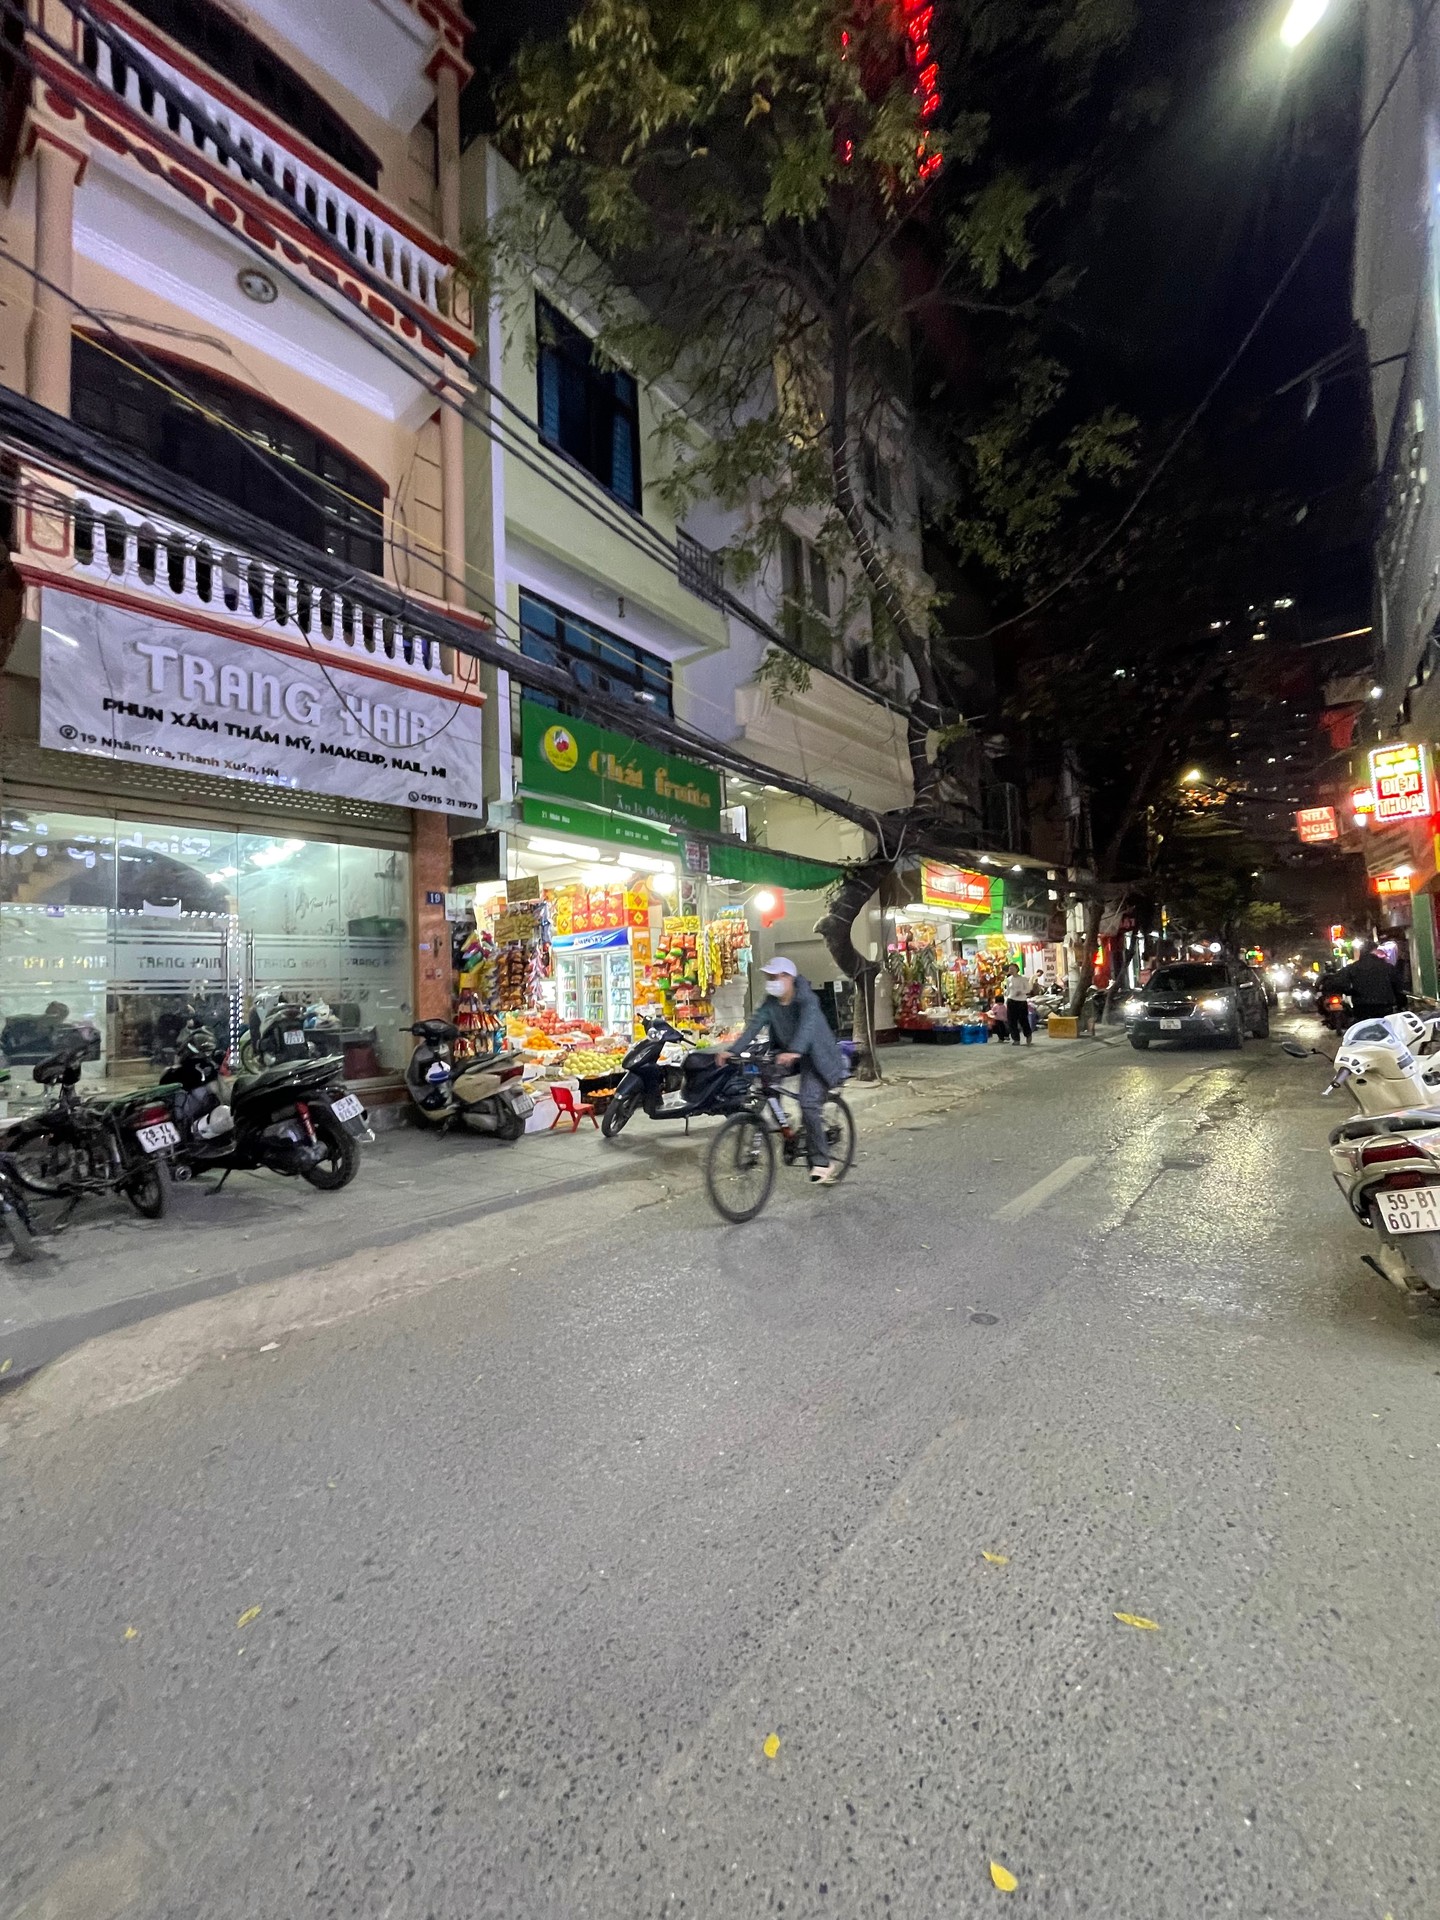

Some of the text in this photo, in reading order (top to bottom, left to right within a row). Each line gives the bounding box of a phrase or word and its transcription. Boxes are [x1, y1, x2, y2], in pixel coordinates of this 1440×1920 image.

[134, 641, 434, 752] TRANG HAIR
[103, 698, 163, 722] PHUN
[171, 711, 218, 733] XĂM
[319, 743, 388, 769] MAKEUP,
[392, 758, 428, 777] NAIL,
[431, 766, 447, 779] MI
[80, 733, 97, 744] 19
[101, 737, 141, 753] Nhân
[177, 751, 219, 767] Thanh
[261, 766, 279, 777] HN
[421, 794, 478, 810] 0915 21 1979
[430, 893, 441, 903] 19
[1387, 1190, 1437, 1211] 59-B1
